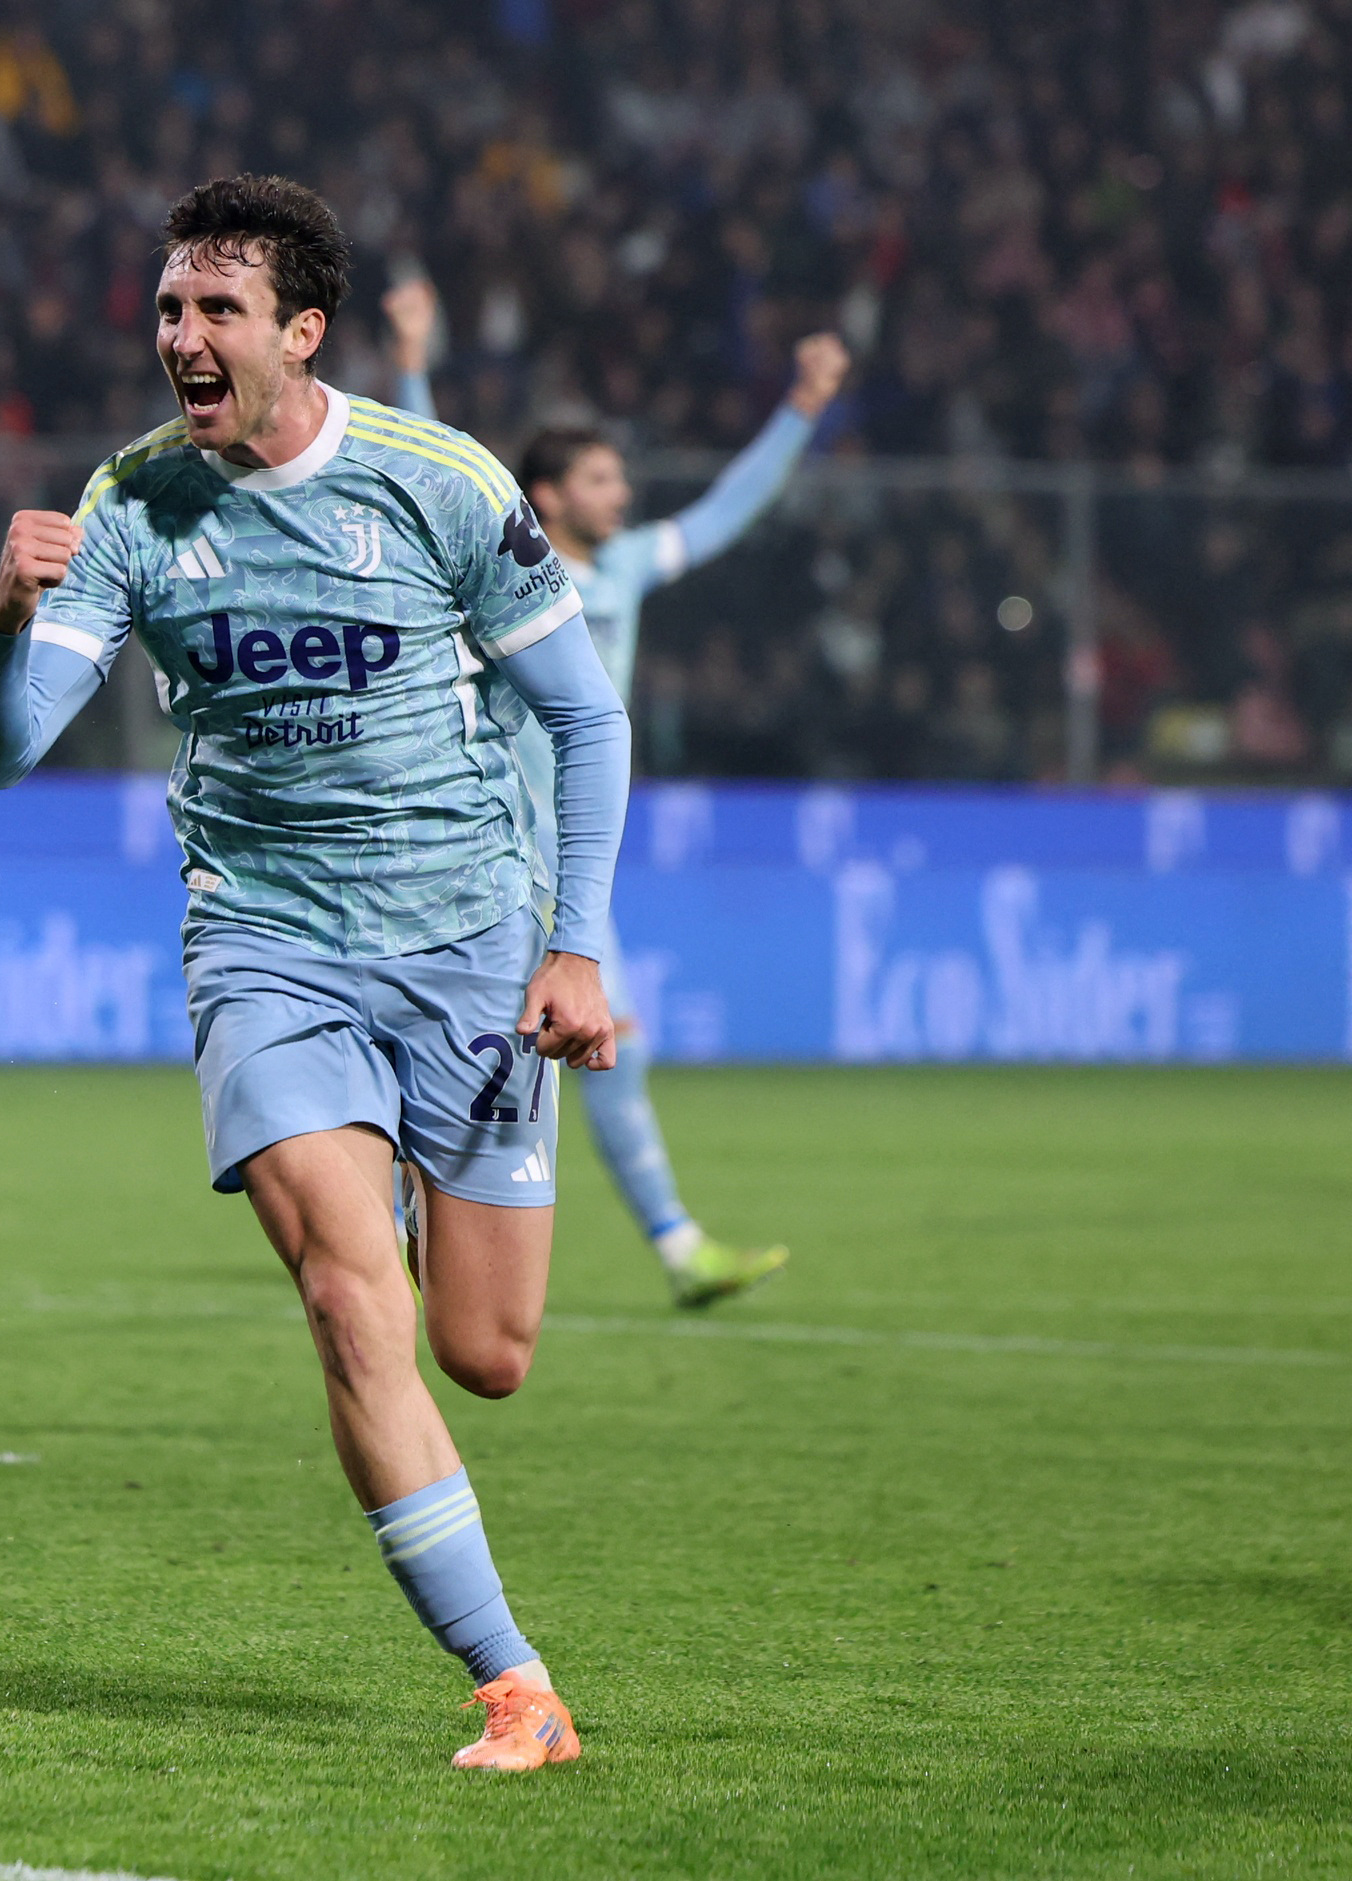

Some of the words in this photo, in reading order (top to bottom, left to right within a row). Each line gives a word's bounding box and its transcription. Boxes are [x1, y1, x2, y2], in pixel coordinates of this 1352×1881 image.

[514, 556, 561, 600] white
[188, 613, 401, 691] Jeep
[262, 690, 332, 718] VISIT
[242, 711, 365, 749] Detroit
